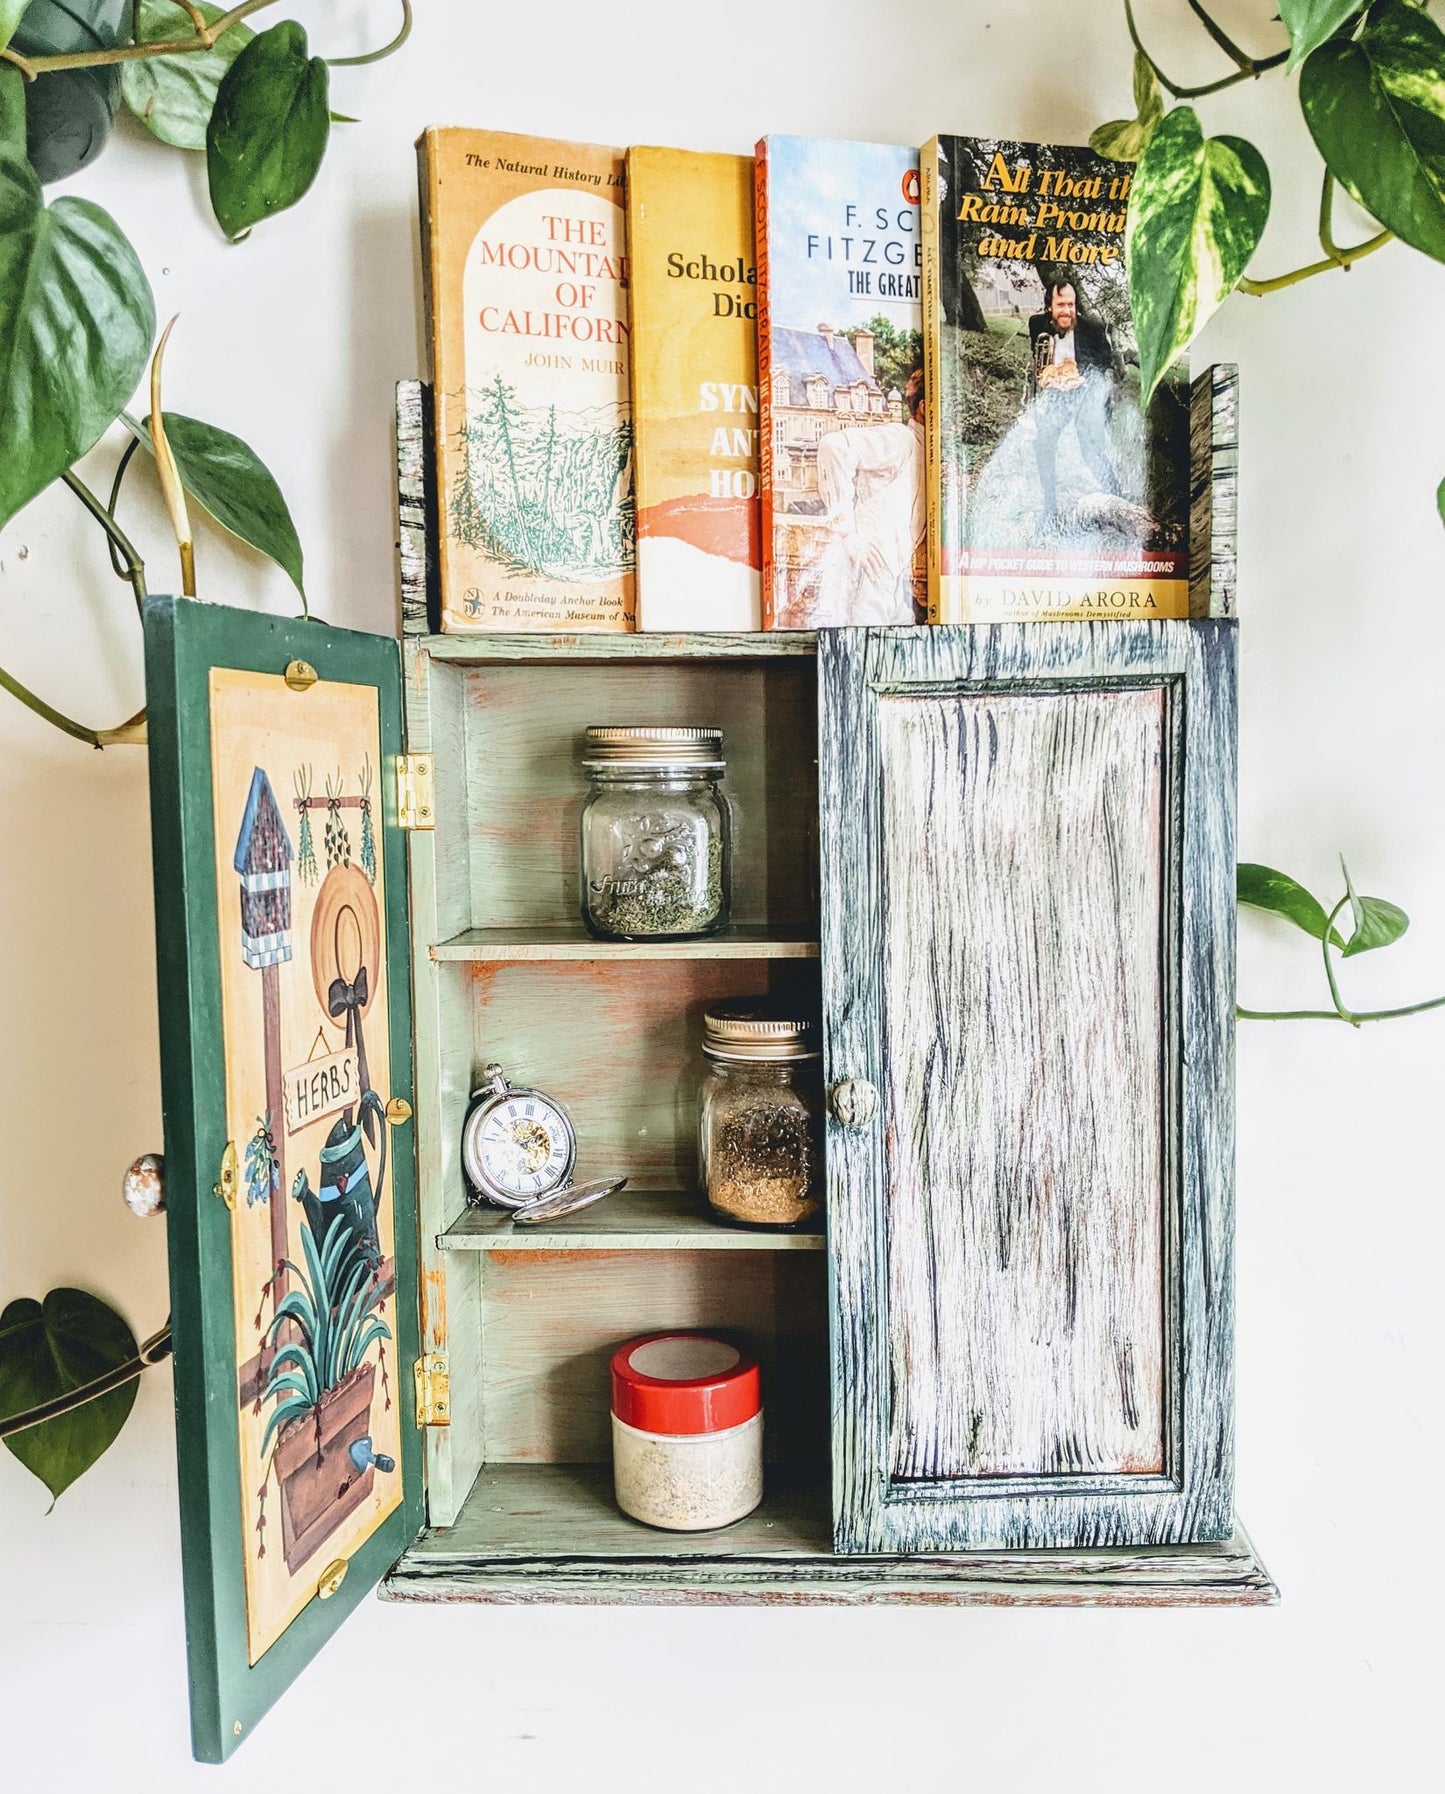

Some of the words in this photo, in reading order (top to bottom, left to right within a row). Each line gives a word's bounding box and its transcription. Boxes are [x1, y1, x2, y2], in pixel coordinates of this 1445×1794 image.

[465, 153, 491, 169] The
[494, 158, 548, 177] Natural
[553, 166, 602, 187] History
[981, 151, 1033, 194] All
[1034, 168, 1106, 199] That
[757, 178, 768, 245] SCOTT
[846, 205, 862, 228] F.
[875, 208, 914, 232] SC
[956, 194, 1028, 226] Rain
[541, 215, 607, 247] THE
[978, 234, 1036, 260] and
[1041, 236, 1119, 267] More
[667, 252, 758, 285] Schola
[847, 270, 872, 295] THE
[878, 272, 921, 299] GREAT
[555, 281, 596, 309] OF
[757, 253, 769, 371] FITZGERALD
[524, 352, 573, 370] JOHN
[581, 357, 626, 376] MUIR
[699, 382, 760, 414] SYN
[759, 377, 770, 399] THE
[760, 402, 771, 440] GREAT
[761, 446, 772, 493] GATSBY
[959, 551, 970, 570] A
[988, 557, 1025, 571] POCKET
[1025, 558, 1054, 571] GUIDE
[1055, 559, 1069, 571] TO
[1069, 559, 1113, 572] WESTERN
[1113, 560, 1176, 574] MUSHROOMS
[491, 606, 511, 617] The
[513, 607, 562, 620] American
[565, 610, 605, 621] Museum
[608, 610, 620, 622] of
[492, 591, 502, 601] A
[504, 591, 557, 606] Doubleday
[560, 595, 596, 606] Anchor
[599, 596, 624, 607] Book
[974, 594, 993, 608] by
[1002, 589, 1072, 607] DAVID
[1079, 591, 1158, 609] ARORA
[1042, 610, 1085, 618] Mushrooms
[1086, 610, 1132, 619] Demystified
[296, 1058, 351, 1119] HERBS
